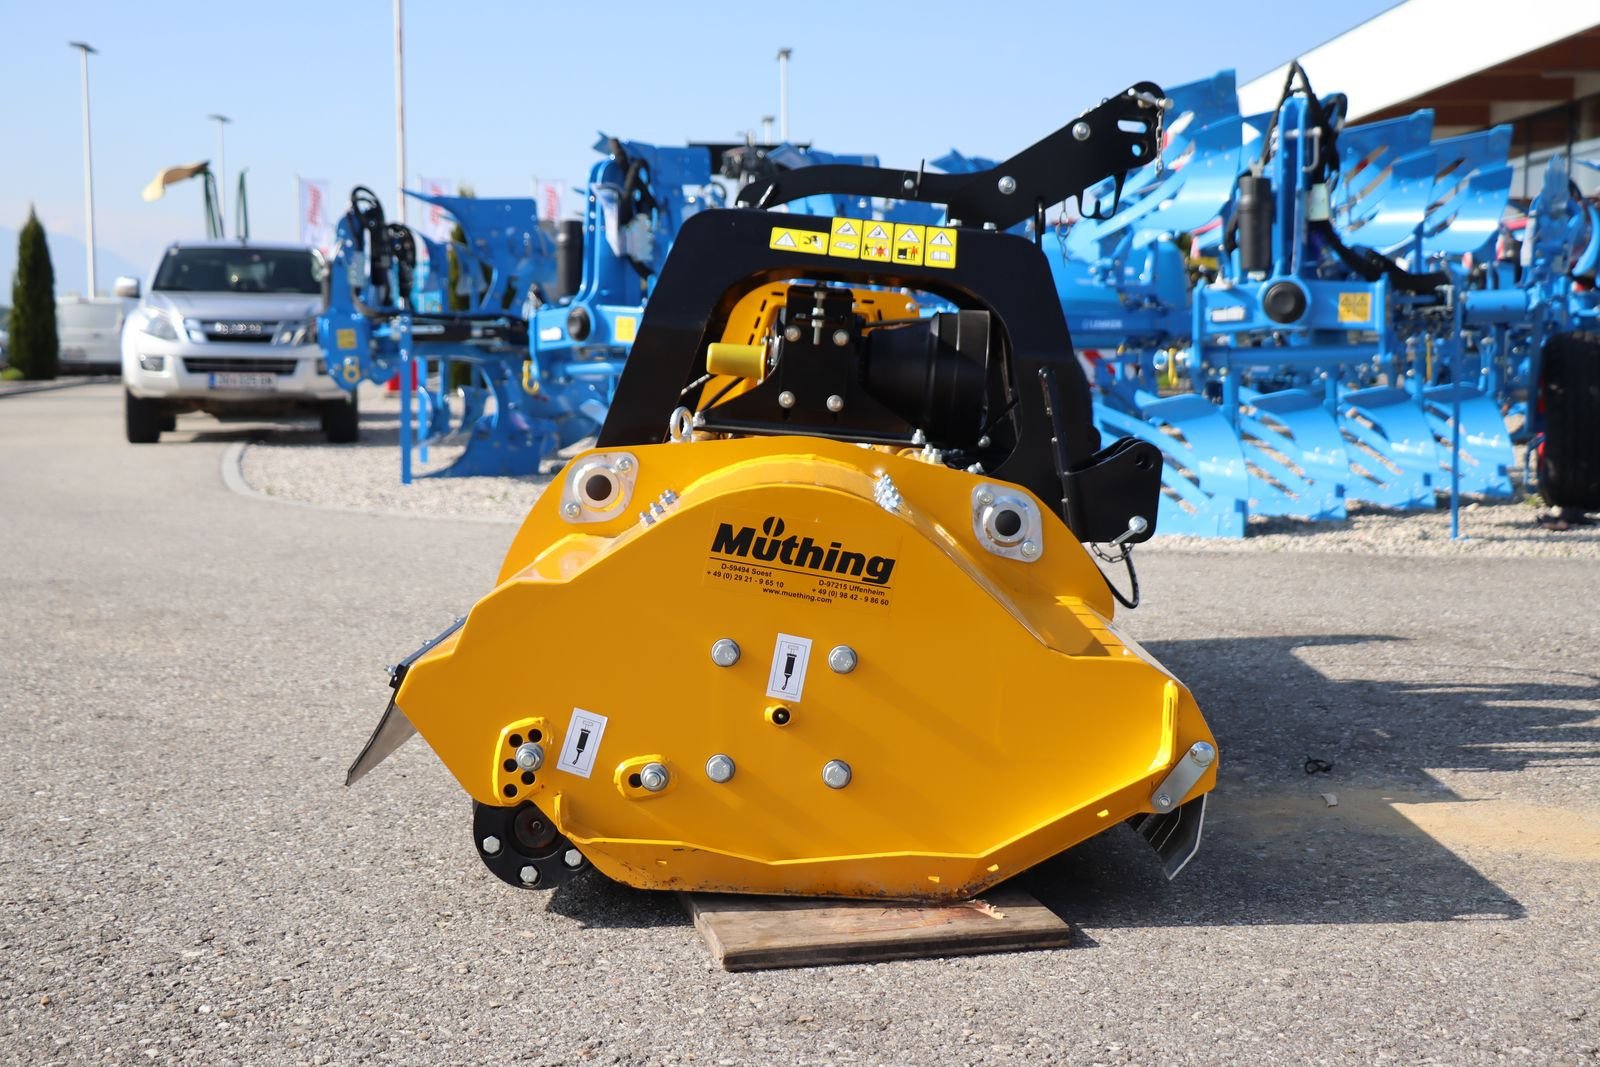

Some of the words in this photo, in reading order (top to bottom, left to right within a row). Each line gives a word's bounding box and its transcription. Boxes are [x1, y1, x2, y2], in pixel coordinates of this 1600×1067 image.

[712, 570, 722, 578] 49
[723, 572, 733, 581] (0)
[734, 573, 743, 581] 29
[744, 575, 753, 583] 21
[721, 563, 750, 573] D-59494
[751, 568, 772, 577] Soest
[763, 587, 832, 604] www.muething.com
[818, 580, 848, 589] D-97215
[849, 585, 885, 597] Uffenheim
[828, 589, 838, 598] (0)
[839, 591, 848, 599] 98
